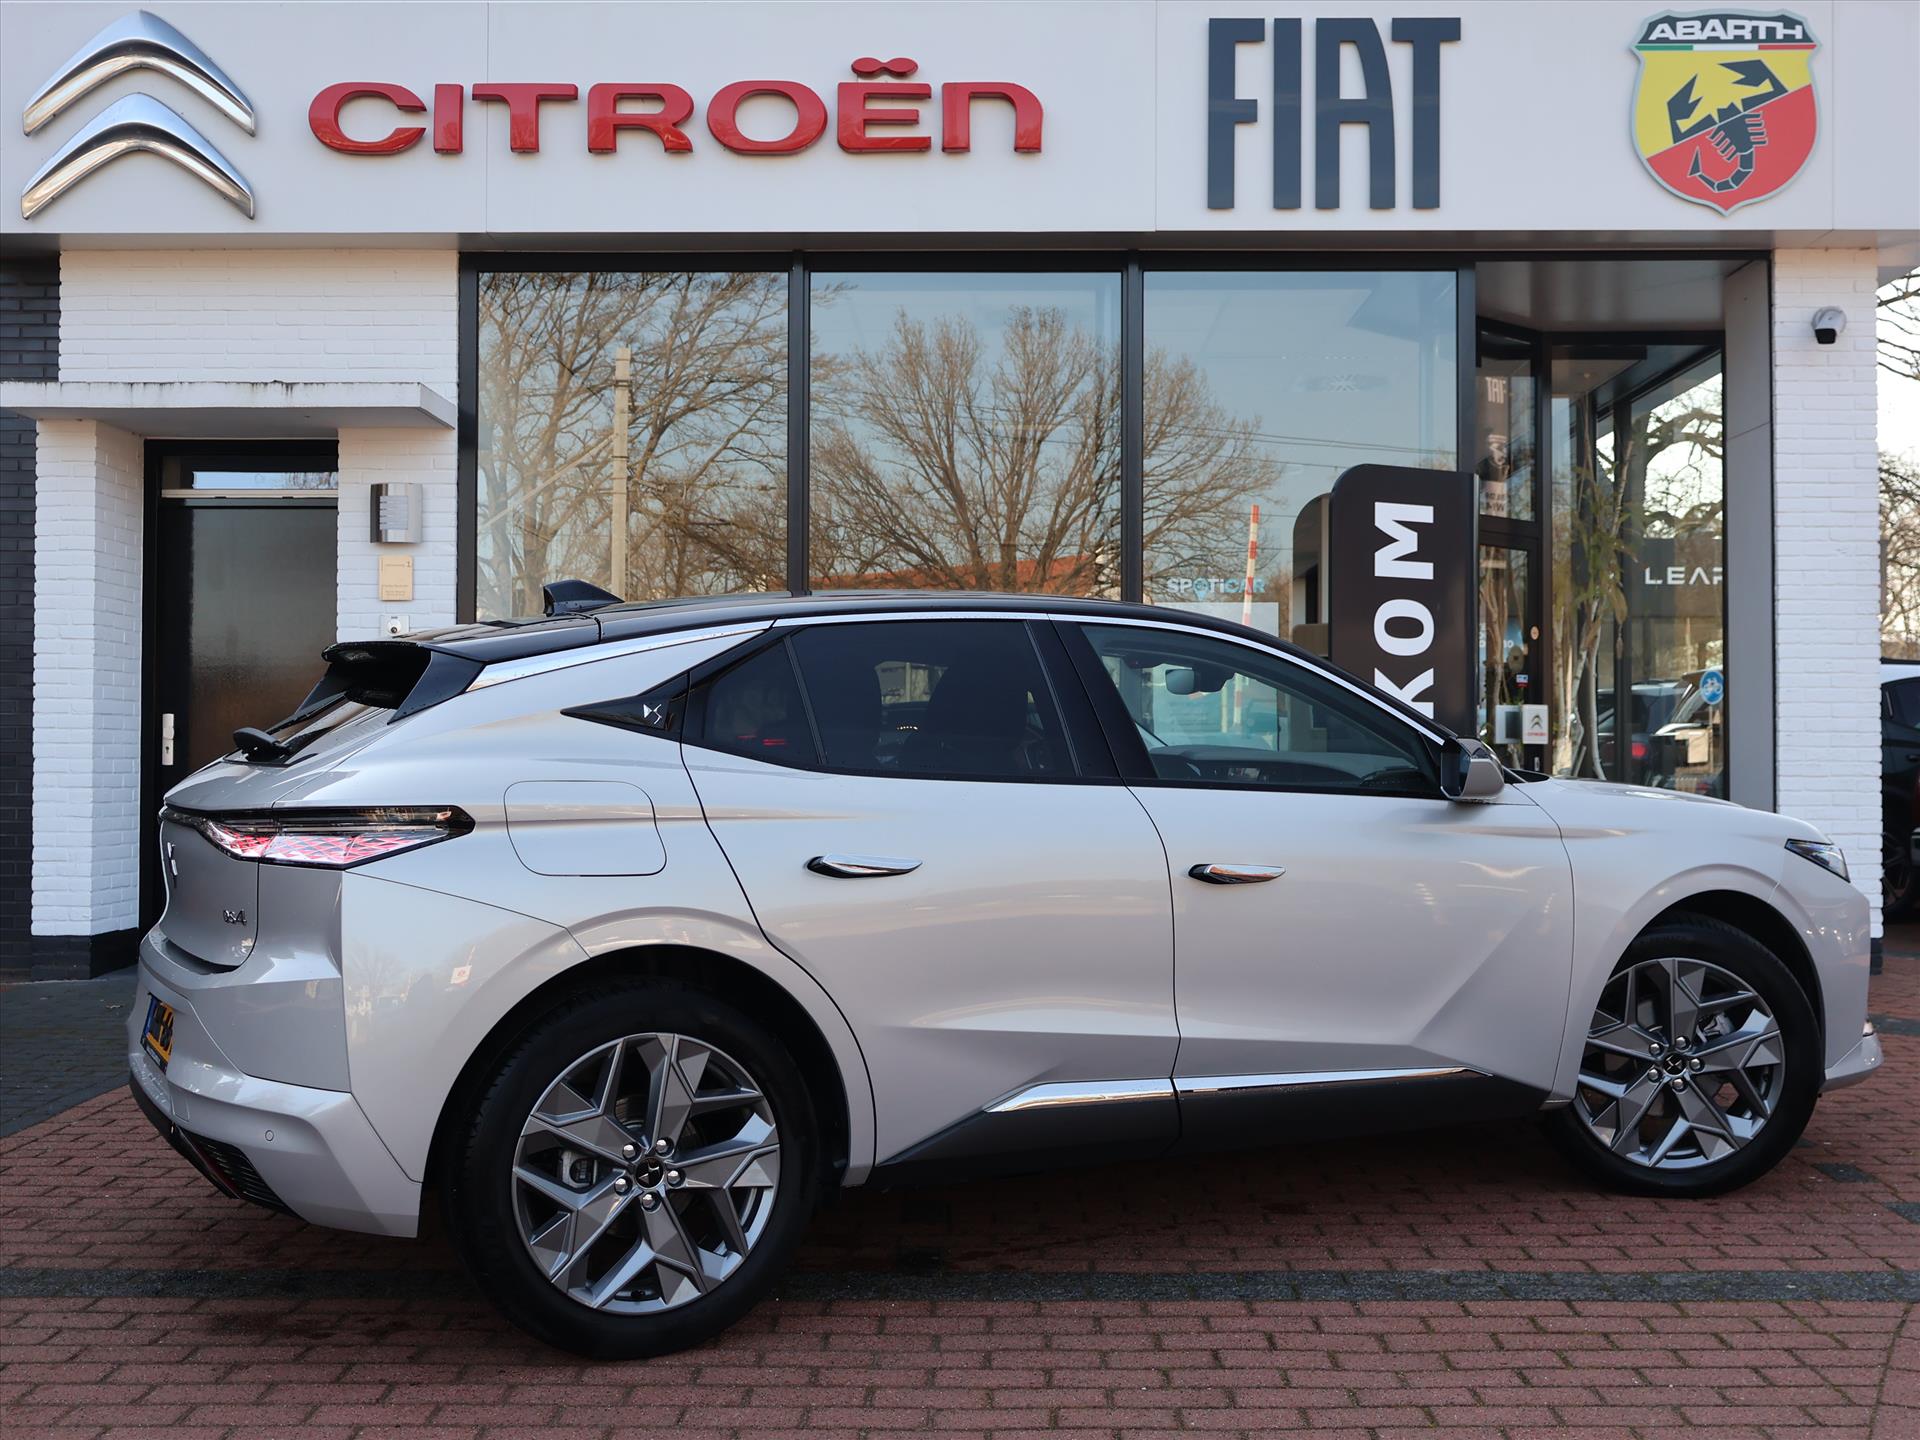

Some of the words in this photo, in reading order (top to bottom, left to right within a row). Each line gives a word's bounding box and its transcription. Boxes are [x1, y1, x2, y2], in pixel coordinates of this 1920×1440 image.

[1648, 19, 1803, 40] ABARTH
[308, 57, 1044, 154] CITROËN
[1207, 17, 1461, 209] FIAT
